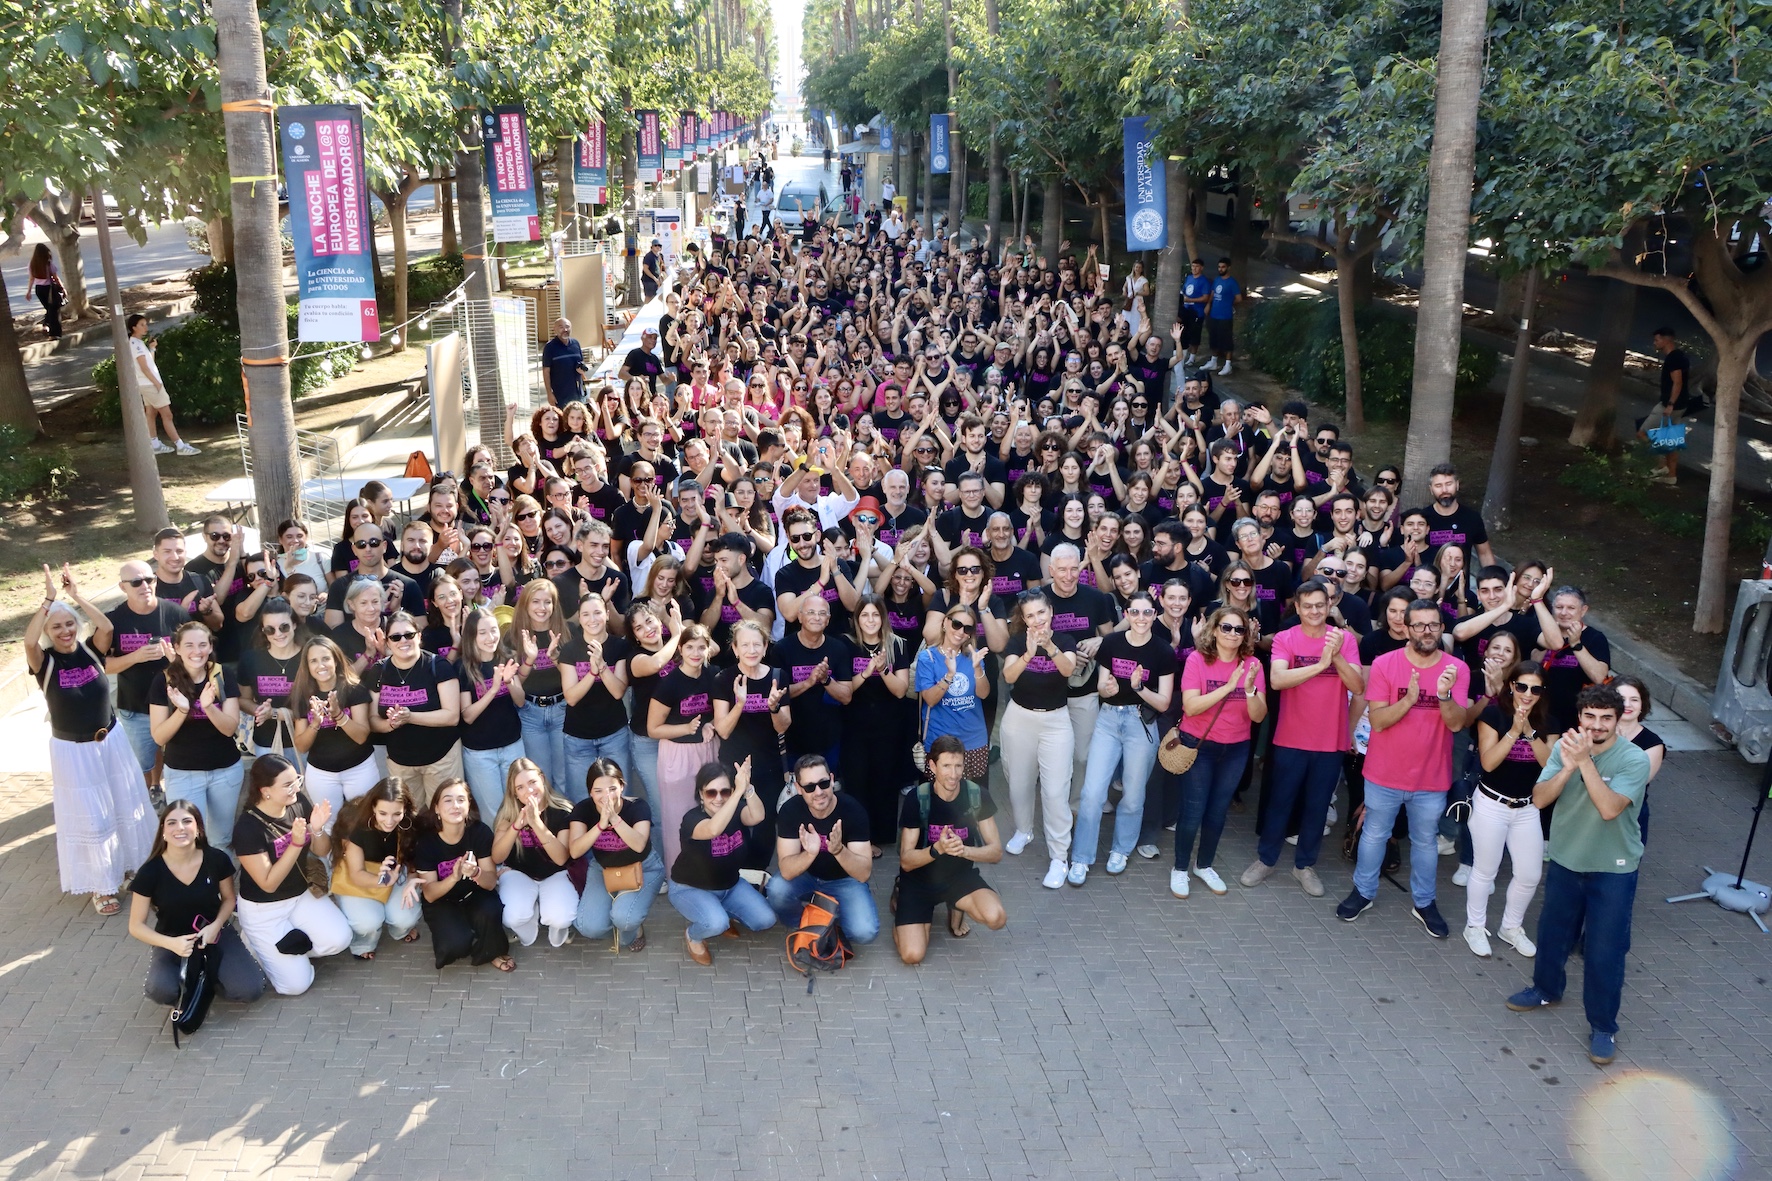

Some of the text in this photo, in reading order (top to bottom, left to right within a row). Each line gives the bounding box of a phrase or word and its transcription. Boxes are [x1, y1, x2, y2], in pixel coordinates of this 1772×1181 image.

[504, 136, 512, 148] DE
[496, 144, 507, 190] LA NOCHE
[506, 150, 516, 189] EUROPEA
[1136, 142, 1145, 204] UNIVERSIDAD
[320, 124, 343, 251] EUROPEA DE L@S
[336, 123, 360, 252] INVESTIGADOR@S
[1145, 189, 1153, 202] DE
[309, 174, 328, 253] LA NOCHE
[308, 285, 322, 293] para
[316, 268, 346, 276] CIENCIA
[364, 307, 374, 316] 62
